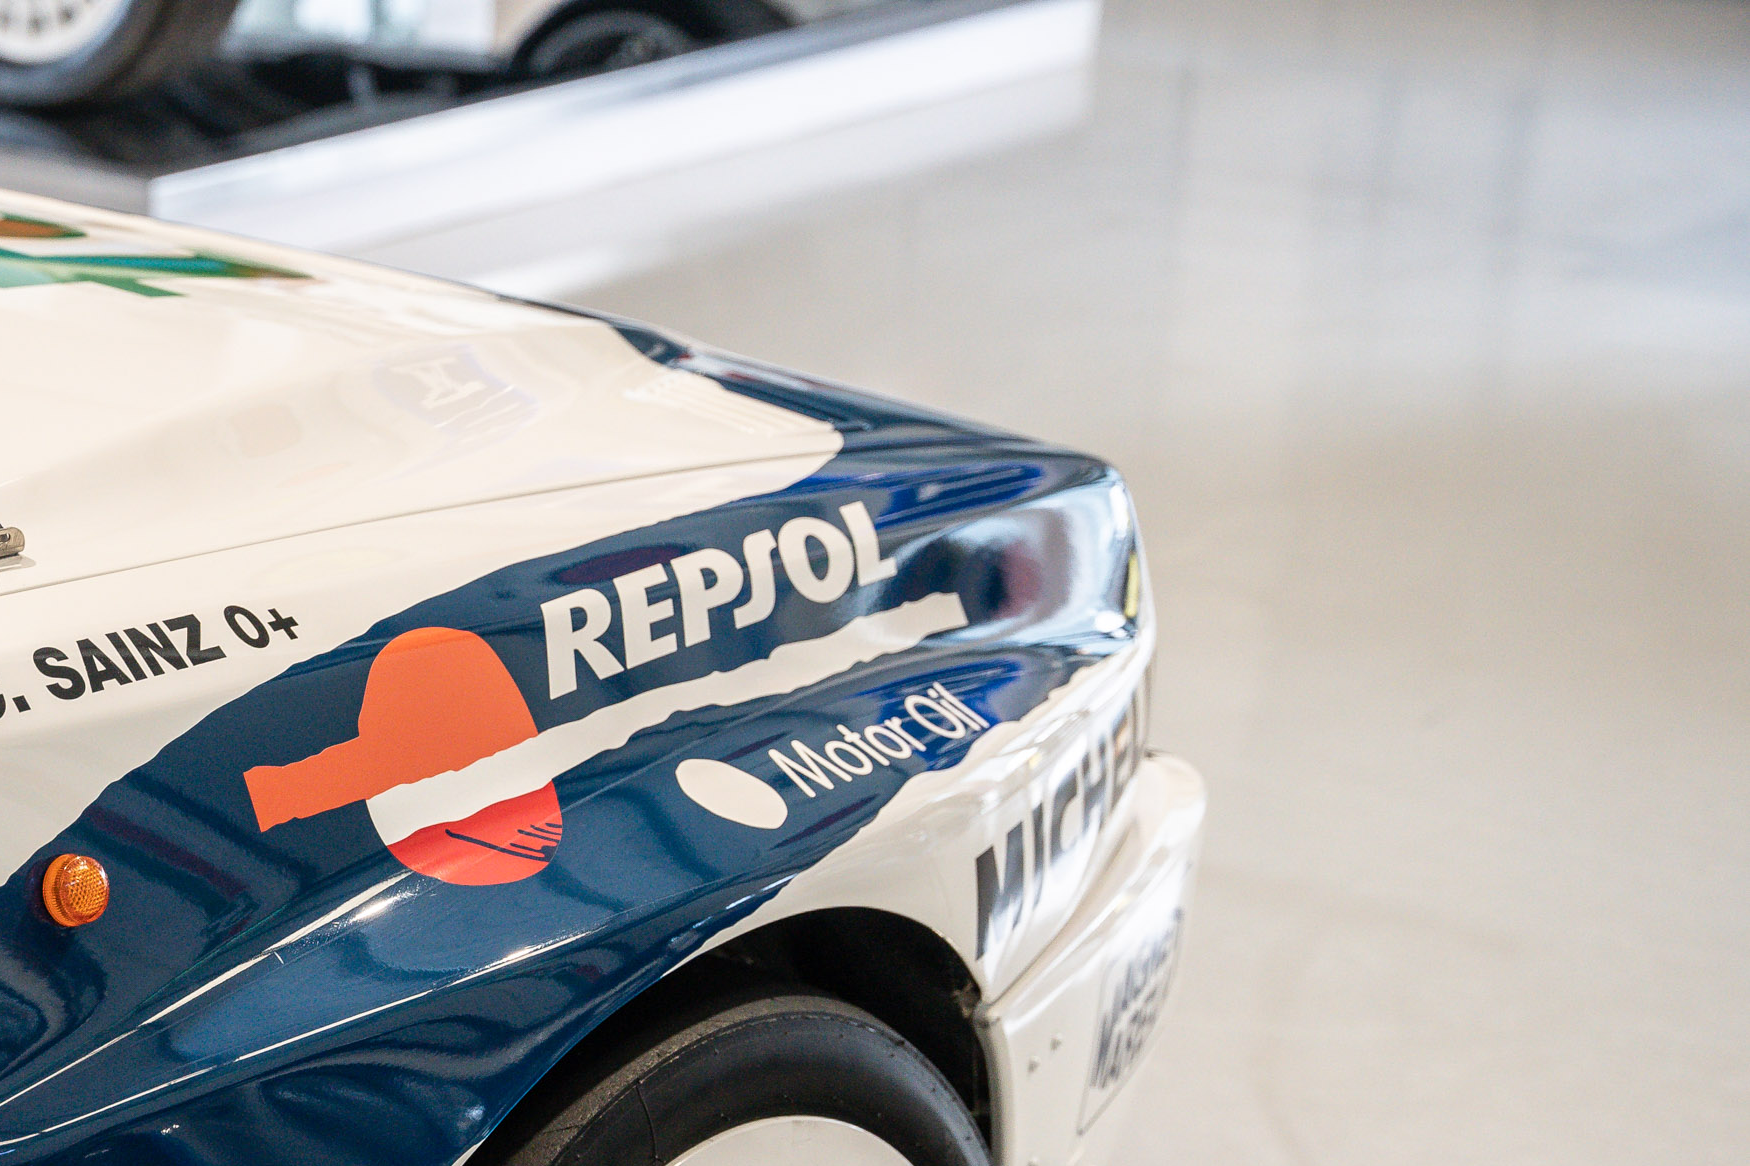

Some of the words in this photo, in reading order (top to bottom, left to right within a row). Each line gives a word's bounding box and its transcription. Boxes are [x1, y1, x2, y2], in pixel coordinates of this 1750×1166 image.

[32, 613, 227, 701] SAINZ
[540, 500, 898, 701] REPSOL
[768, 716, 914, 799] Motor
[905, 681, 991, 732] Oil
